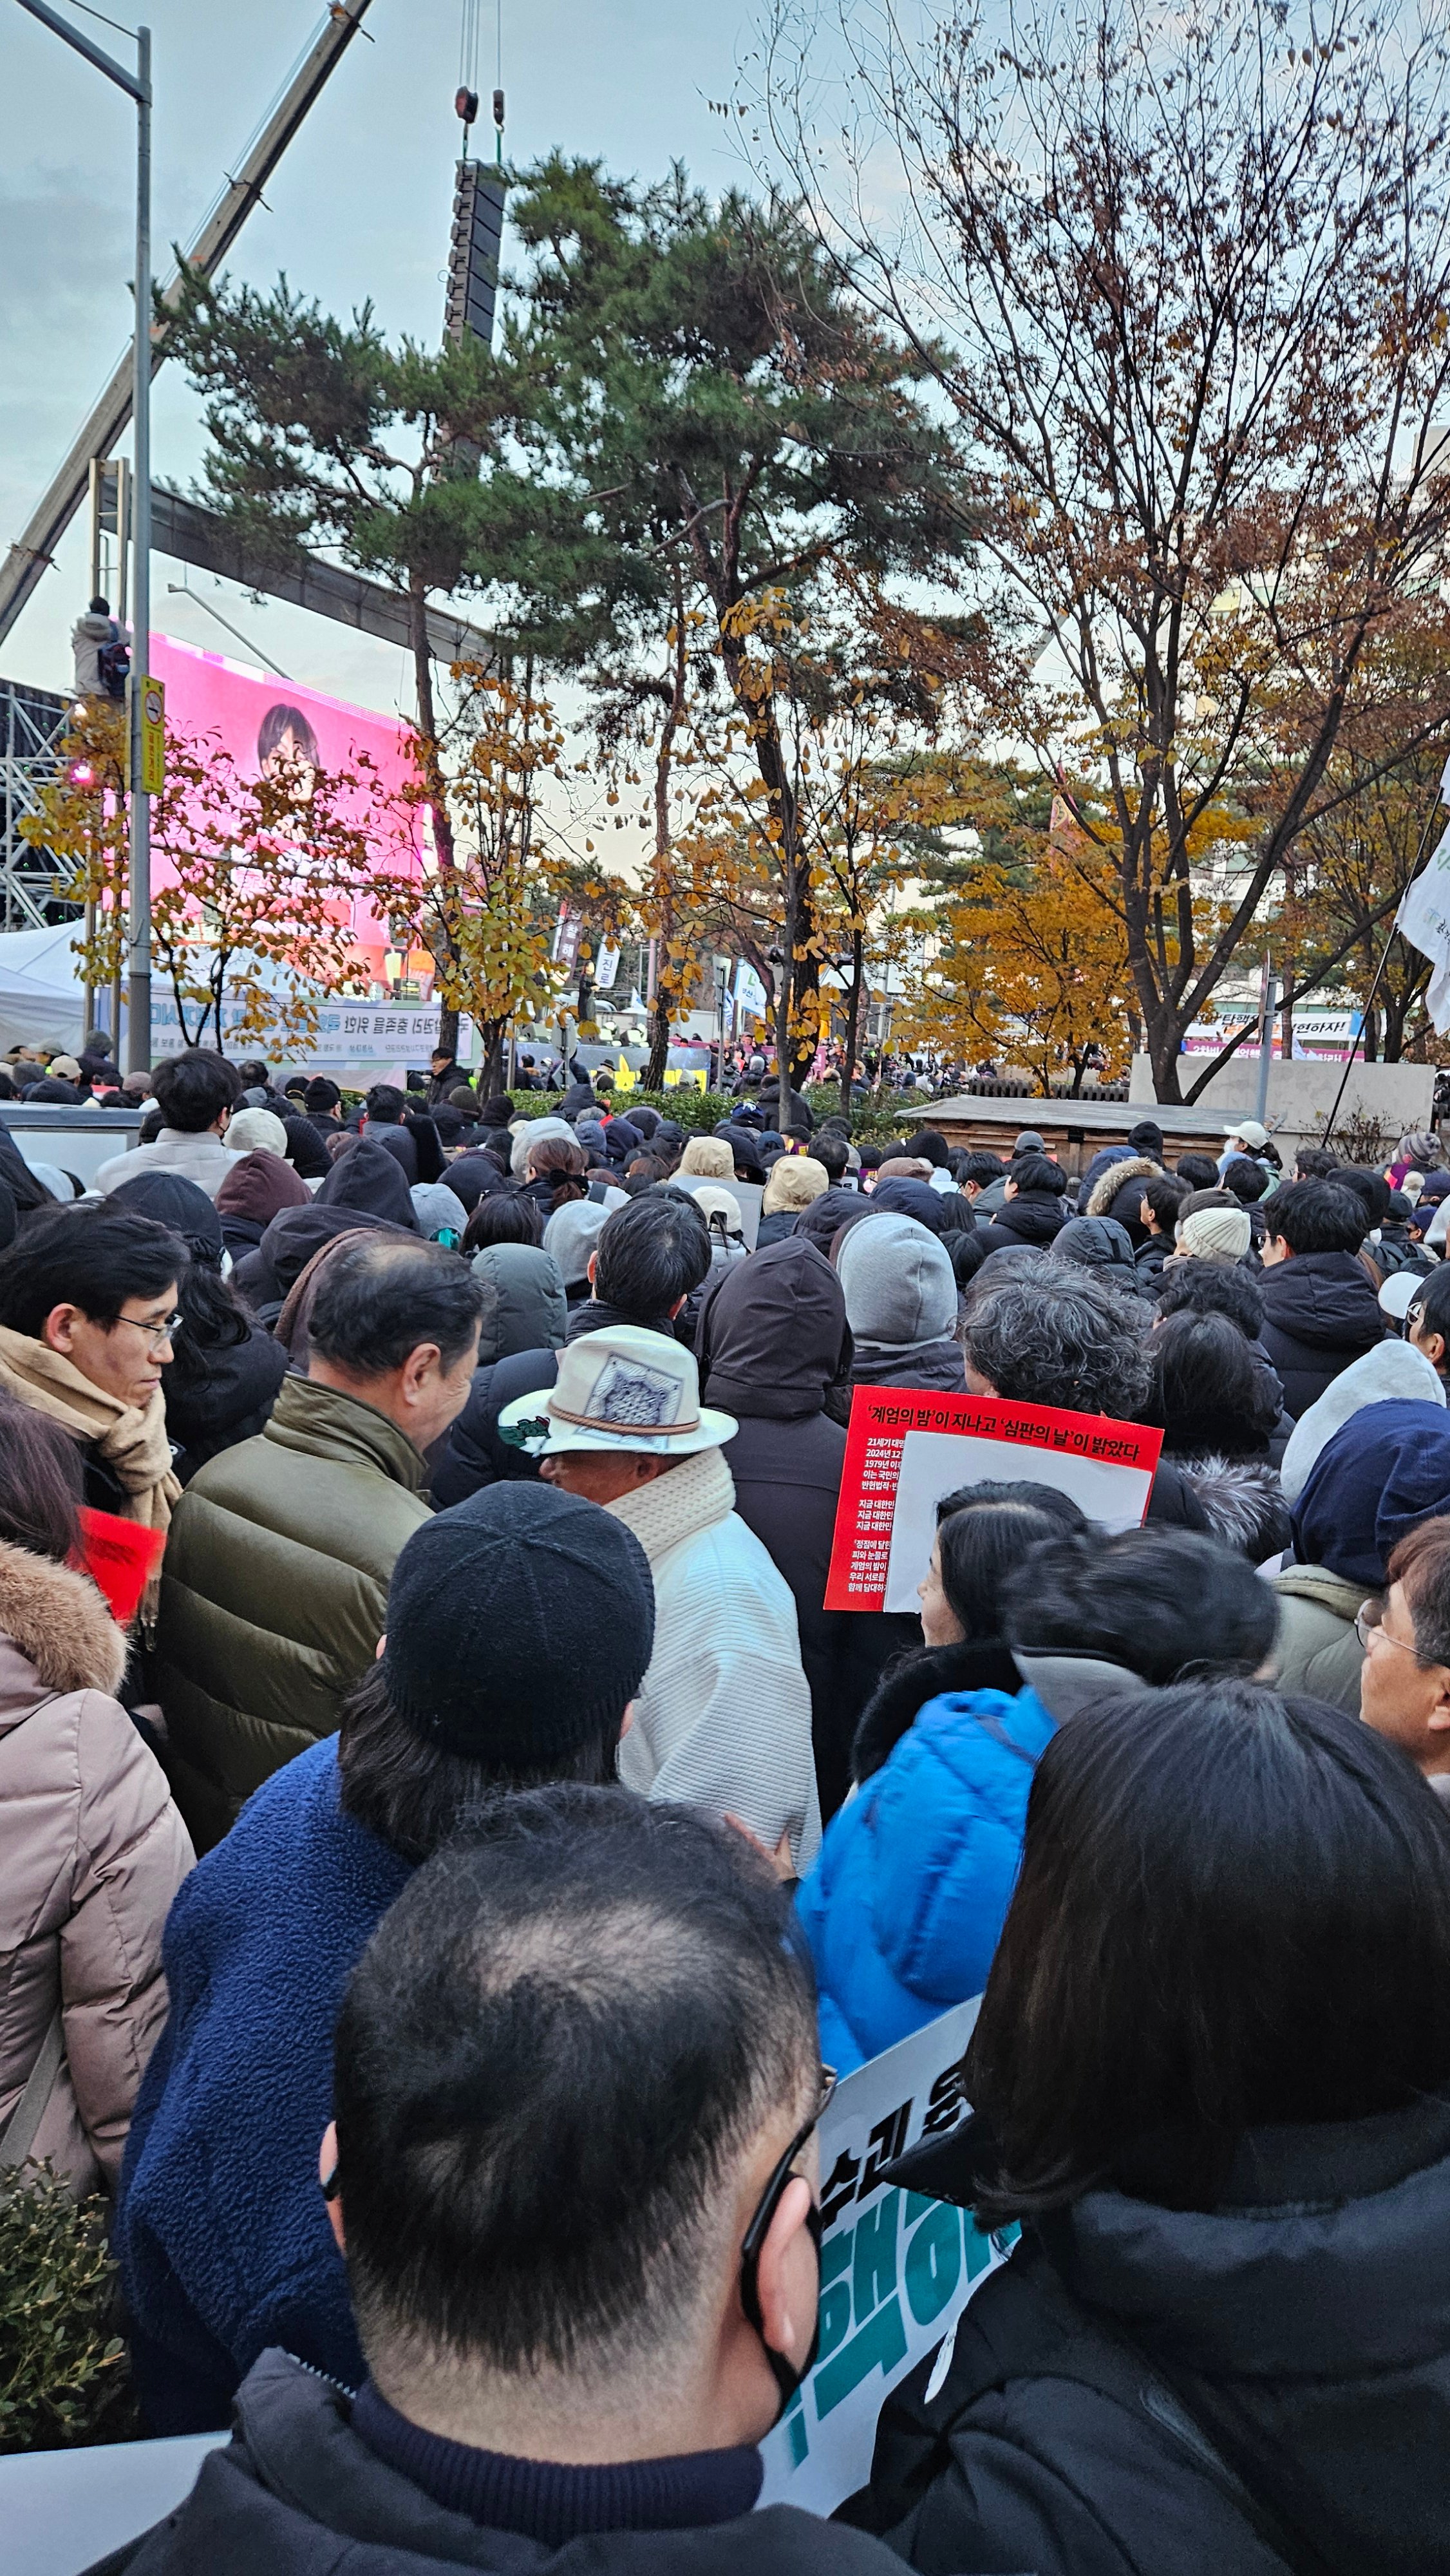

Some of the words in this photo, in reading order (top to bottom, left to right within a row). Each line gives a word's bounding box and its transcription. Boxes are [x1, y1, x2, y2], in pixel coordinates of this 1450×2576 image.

[917, 1409, 950, 1429] 밤’이
[951, 1412, 996, 1433] 지나고
[1053, 1427, 1089, 1452] 날’이
[1091, 1435, 1140, 1462] 밝았다
[867, 1437, 891, 1448] 21세기
[866, 1448, 891, 1459] 2024년
[891, 1450, 903, 1459] 12
[865, 1459, 890, 1469] 1979년
[863, 1469, 878, 1479] 이는
[878, 1470, 899, 1480] 국민의
[859, 1500, 873, 1510] 지금
[858, 1510, 872, 1520] 지금
[856, 1521, 871, 1531] 지금
[852, 1551, 867, 1560] 피와
[867, 1551, 888, 1560] 눈물로
[851, 1562, 872, 1571] 계엄의
[872, 1562, 887, 1571] 밤이
[849, 1573, 863, 1582] 우리
[865, 1573, 885, 1582] 서로를
[848, 1583, 862, 1593] 함께
